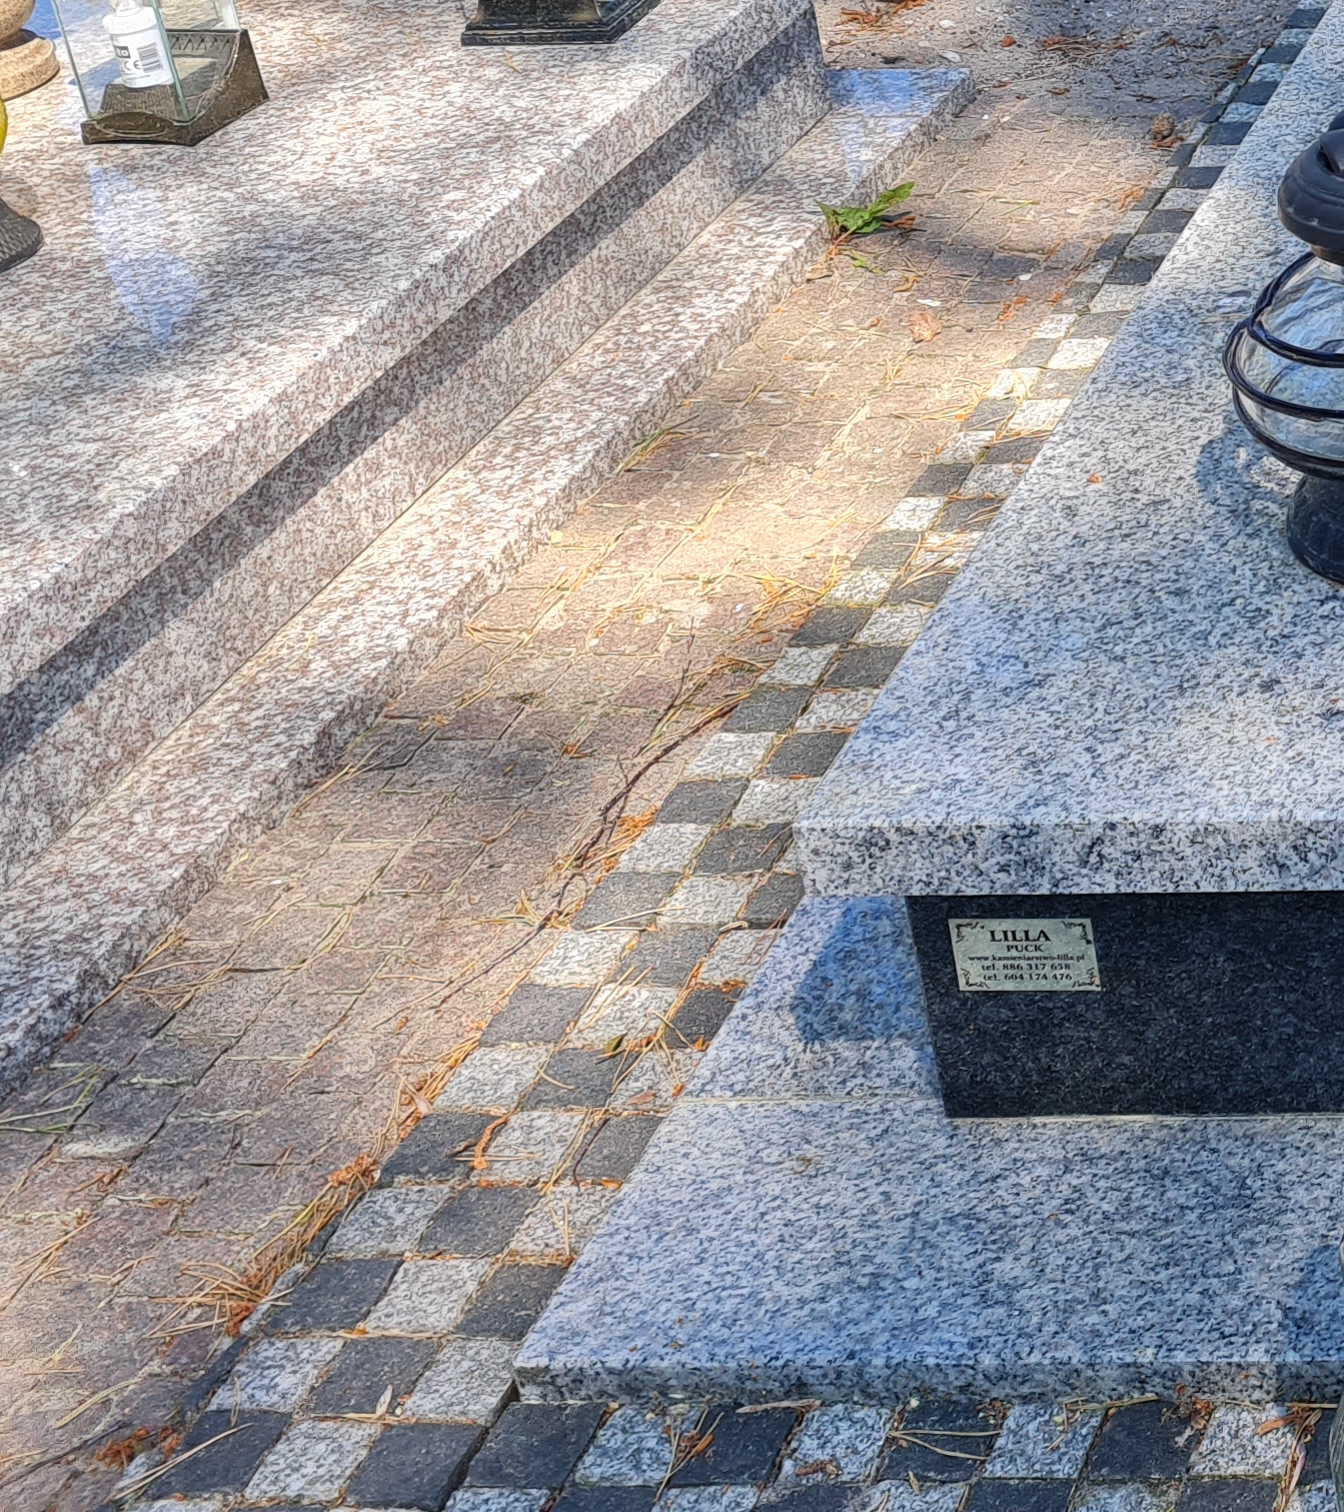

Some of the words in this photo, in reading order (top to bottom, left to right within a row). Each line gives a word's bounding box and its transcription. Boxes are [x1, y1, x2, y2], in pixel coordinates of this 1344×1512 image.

[989, 929, 1051, 943] LILLA
[1006, 944, 1044, 953] PUCK
[981, 962, 999, 971] tel.
[1026, 963, 1046, 971] 317
[983, 973, 1001, 982] tel.
[1004, 973, 1025, 981] 604
[1029, 973, 1048, 981] 174
[1051, 973, 1073, 981] 476
